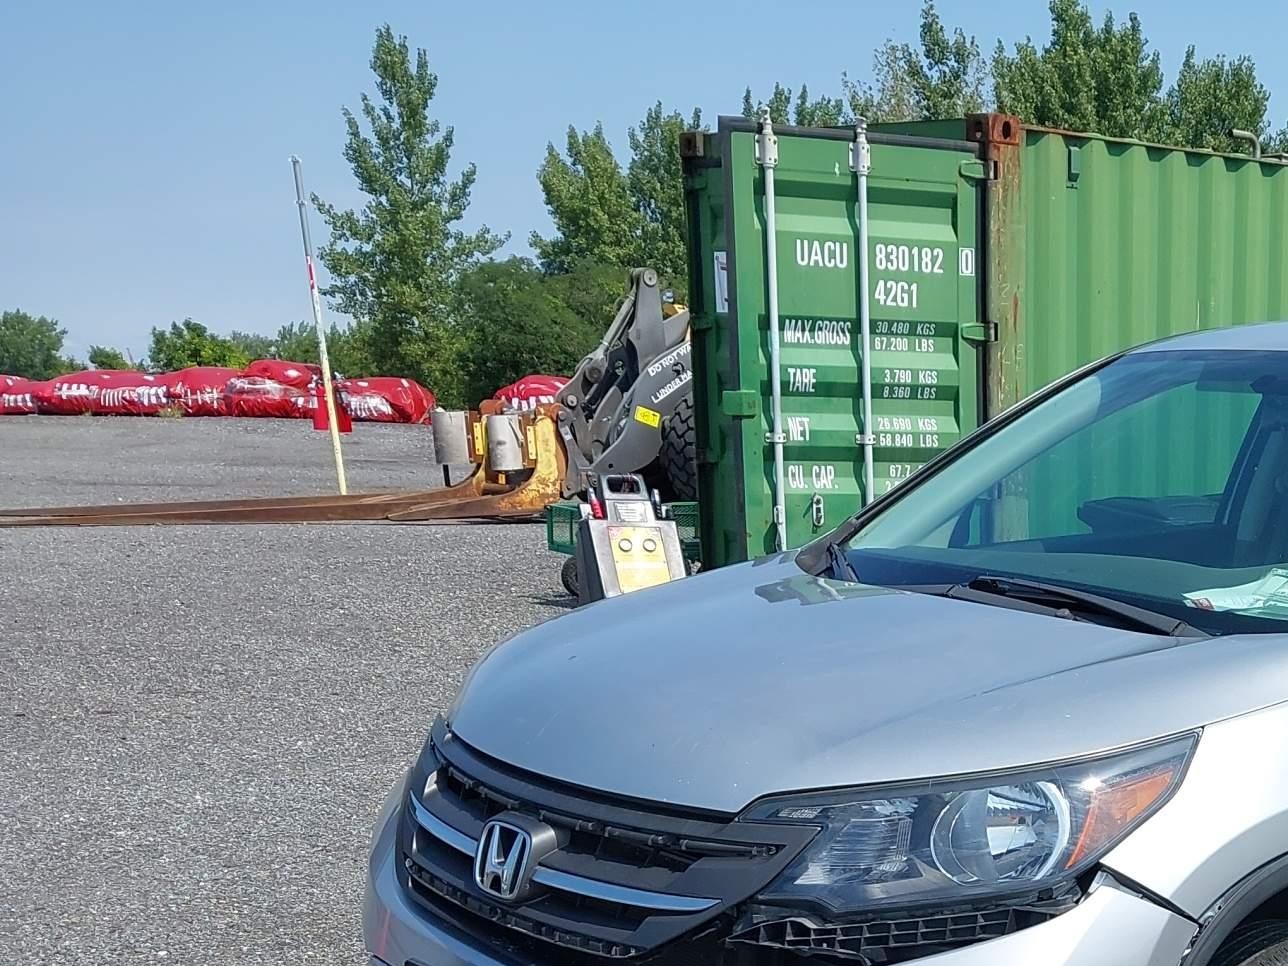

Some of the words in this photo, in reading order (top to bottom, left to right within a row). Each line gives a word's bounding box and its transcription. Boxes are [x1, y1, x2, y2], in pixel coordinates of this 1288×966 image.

[796, 239, 848, 269] UACU
[875, 243, 944, 274] 830182
[961, 249, 973, 274] 0
[874, 279, 918, 308] 42G1
[784, 319, 851, 345] MAX.GROSS
[876, 321, 909, 335] 30.480
[916, 323, 936, 336] KGS
[874, 337, 908, 351] 67.200
[915, 338, 934, 352] LBS
[648, 363, 662, 377] DO
[663, 351, 681, 368] NOT
[787, 367, 817, 392] TARE
[884, 369, 912, 383] 3.790
[918, 370, 938, 384] KGS
[883, 386, 910, 399] 8.360
[917, 387, 937, 399] LBS
[787, 416, 810, 442] NET
[918, 418, 938, 431] KGS
[880, 433, 913, 447] 58.840
[919, 434, 939, 448] LBS
[788, 465, 808, 489] CU.
[812, 465, 838, 489] CAP.
